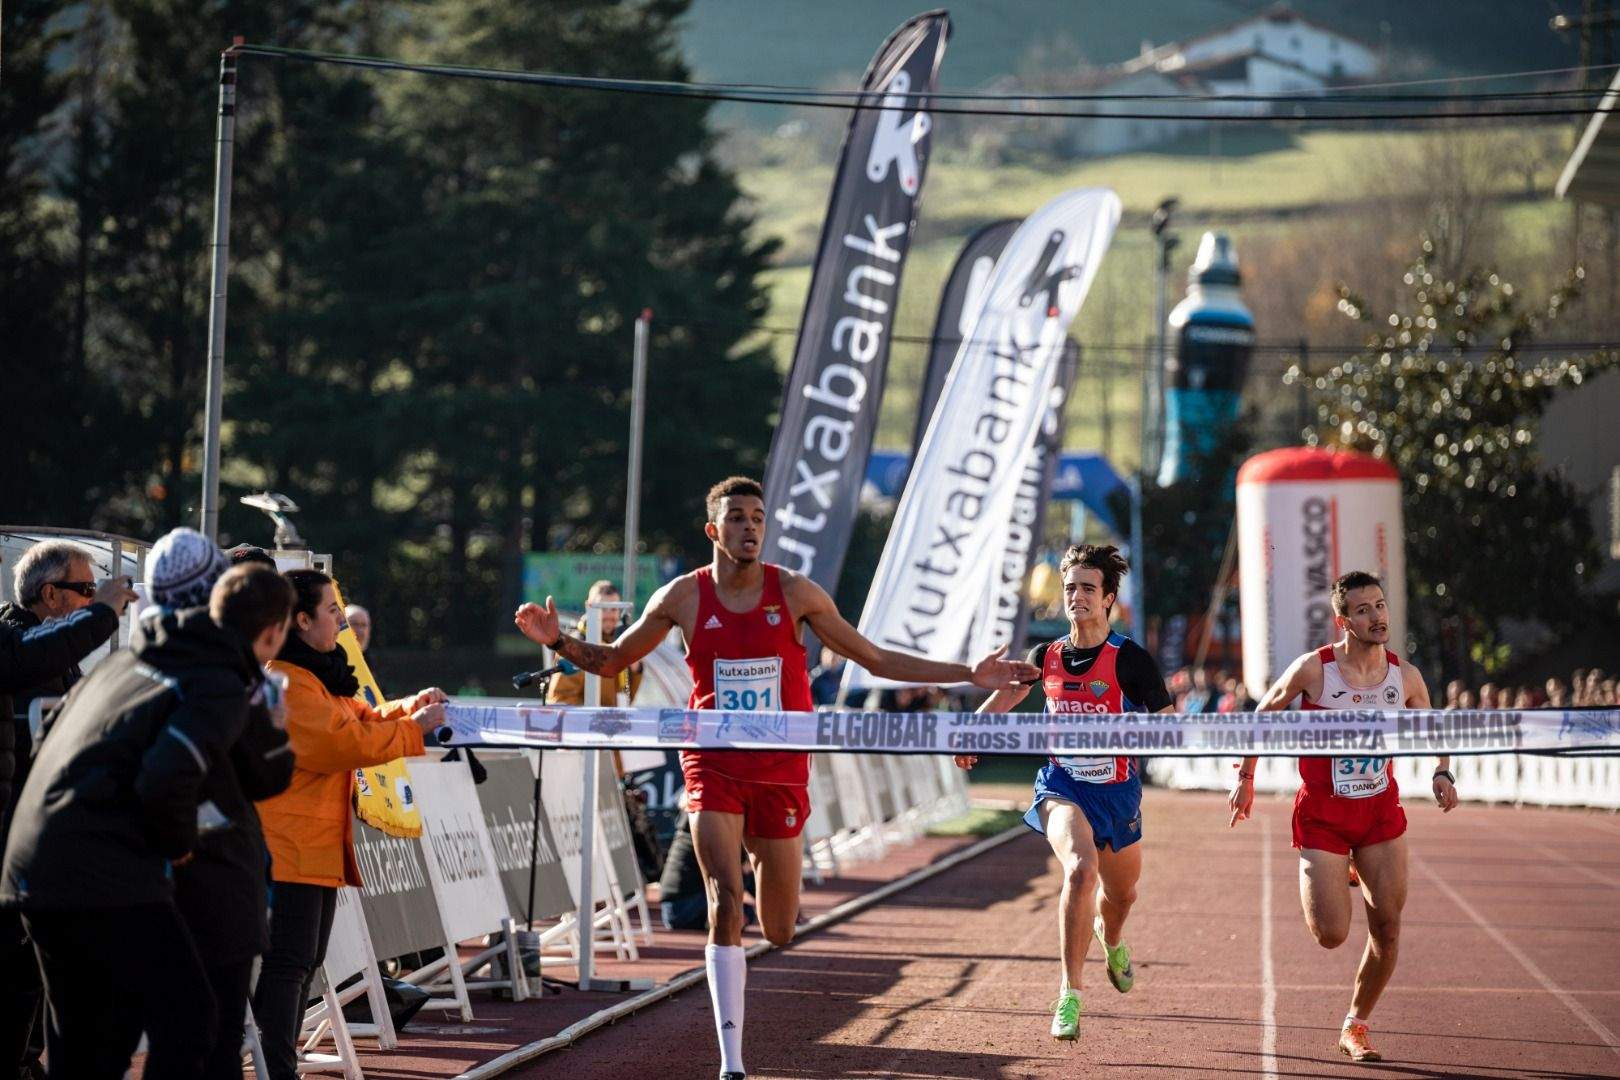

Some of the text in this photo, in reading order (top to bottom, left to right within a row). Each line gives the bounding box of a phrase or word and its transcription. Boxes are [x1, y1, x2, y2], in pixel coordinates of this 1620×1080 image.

[775, 213, 906, 577] utxabank
[884, 328, 1042, 656] kutxabank
[1303, 497, 1329, 592] VASCO
[718, 664, 777, 677] kutxabank
[722, 687, 771, 711] 301
[1309, 710, 1386, 724] KROSA
[816, 711, 938, 748] ELGOIBAR
[948, 731, 1021, 750] CROSS
[1200, 729, 1255, 750] JUAN
[1262, 729, 1388, 751] MUGUERZA
[1398, 710, 1523, 750] ELGOIBAR
[1339, 757, 1386, 775] 370
[353, 825, 426, 898] utxabank
